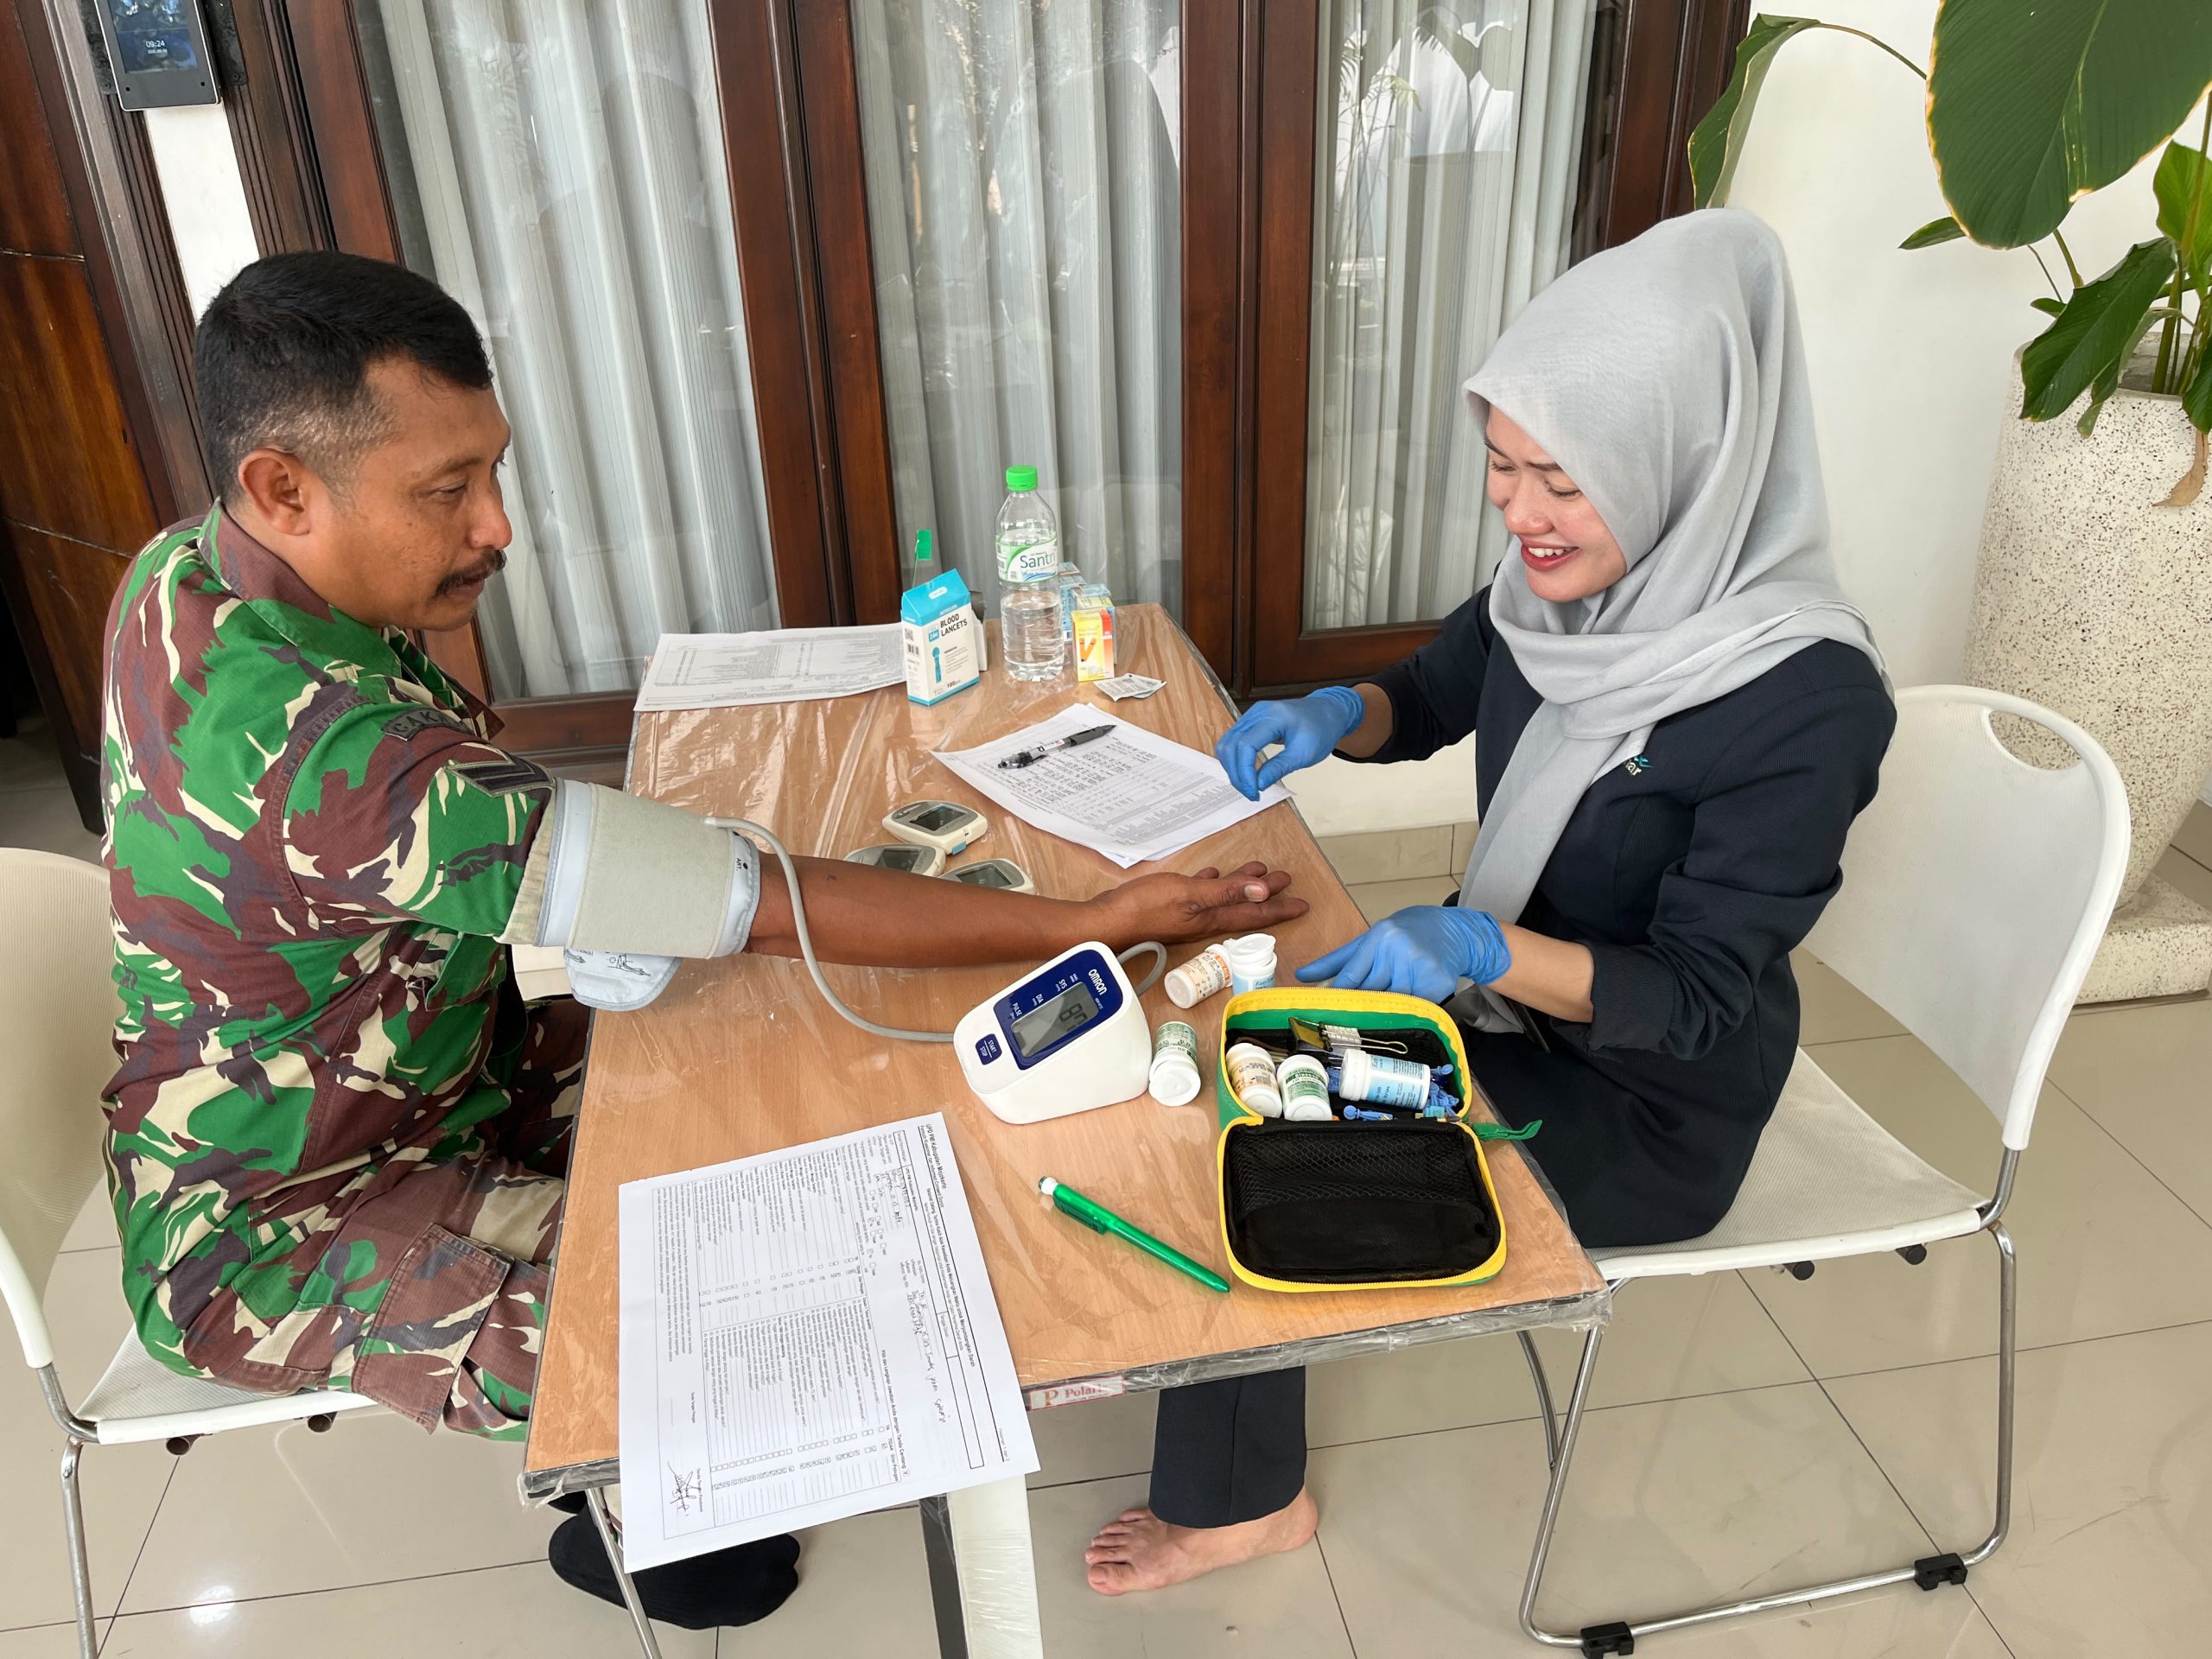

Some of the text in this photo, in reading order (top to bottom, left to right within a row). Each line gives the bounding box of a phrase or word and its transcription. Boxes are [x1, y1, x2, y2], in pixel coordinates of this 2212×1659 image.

[145, 40, 165, 48] 09:24
[940, 613, 959, 628] BLOOD
[941, 619, 968, 637] LANCETS
[1058, 978, 1068, 989] SYS
[1088, 969, 1107, 995] OMRON
[1035, 993, 1044, 1004] DIA
[1012, 1002, 1023, 1017] PULSE
[980, 1046, 988, 1057] STOP
[988, 1039, 997, 1053] START
[930, 1141, 941, 1166] Kabupaten
[936, 1166, 948, 1189] Mojokerto
[1043, 1389, 1058, 1407] P
[1065, 1383, 1109, 1398] Polar
